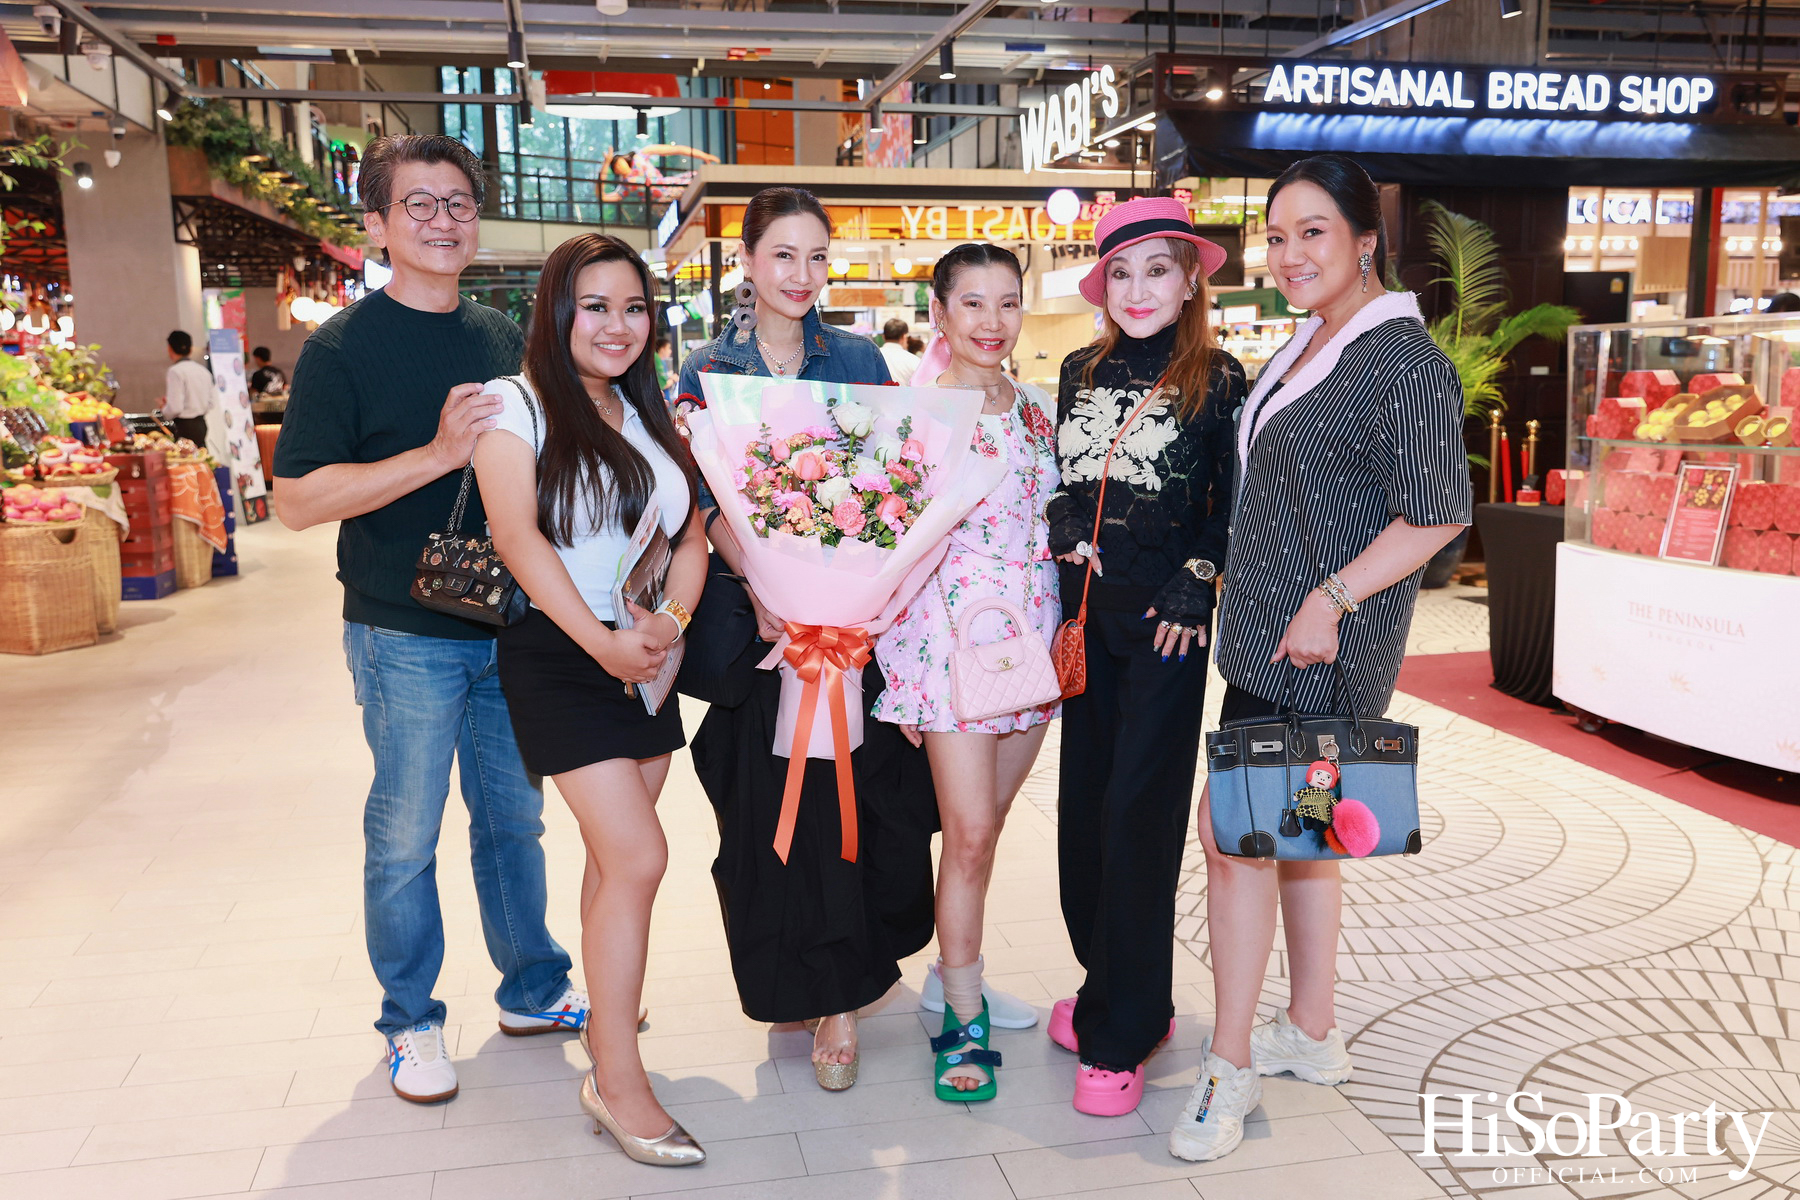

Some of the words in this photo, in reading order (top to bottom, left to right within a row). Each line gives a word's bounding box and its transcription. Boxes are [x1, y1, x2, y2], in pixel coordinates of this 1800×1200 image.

[1264, 64, 1475, 109] ARTISANAL
[1488, 71, 1611, 113] BREAD
[1618, 76, 1715, 115] SHOP
[1019, 64, 1119, 174] WABI'S
[1568, 195, 1671, 225] LOCAL
[1628, 600, 1654, 620] THE
[1658, 607, 1746, 638] PENINSULA
